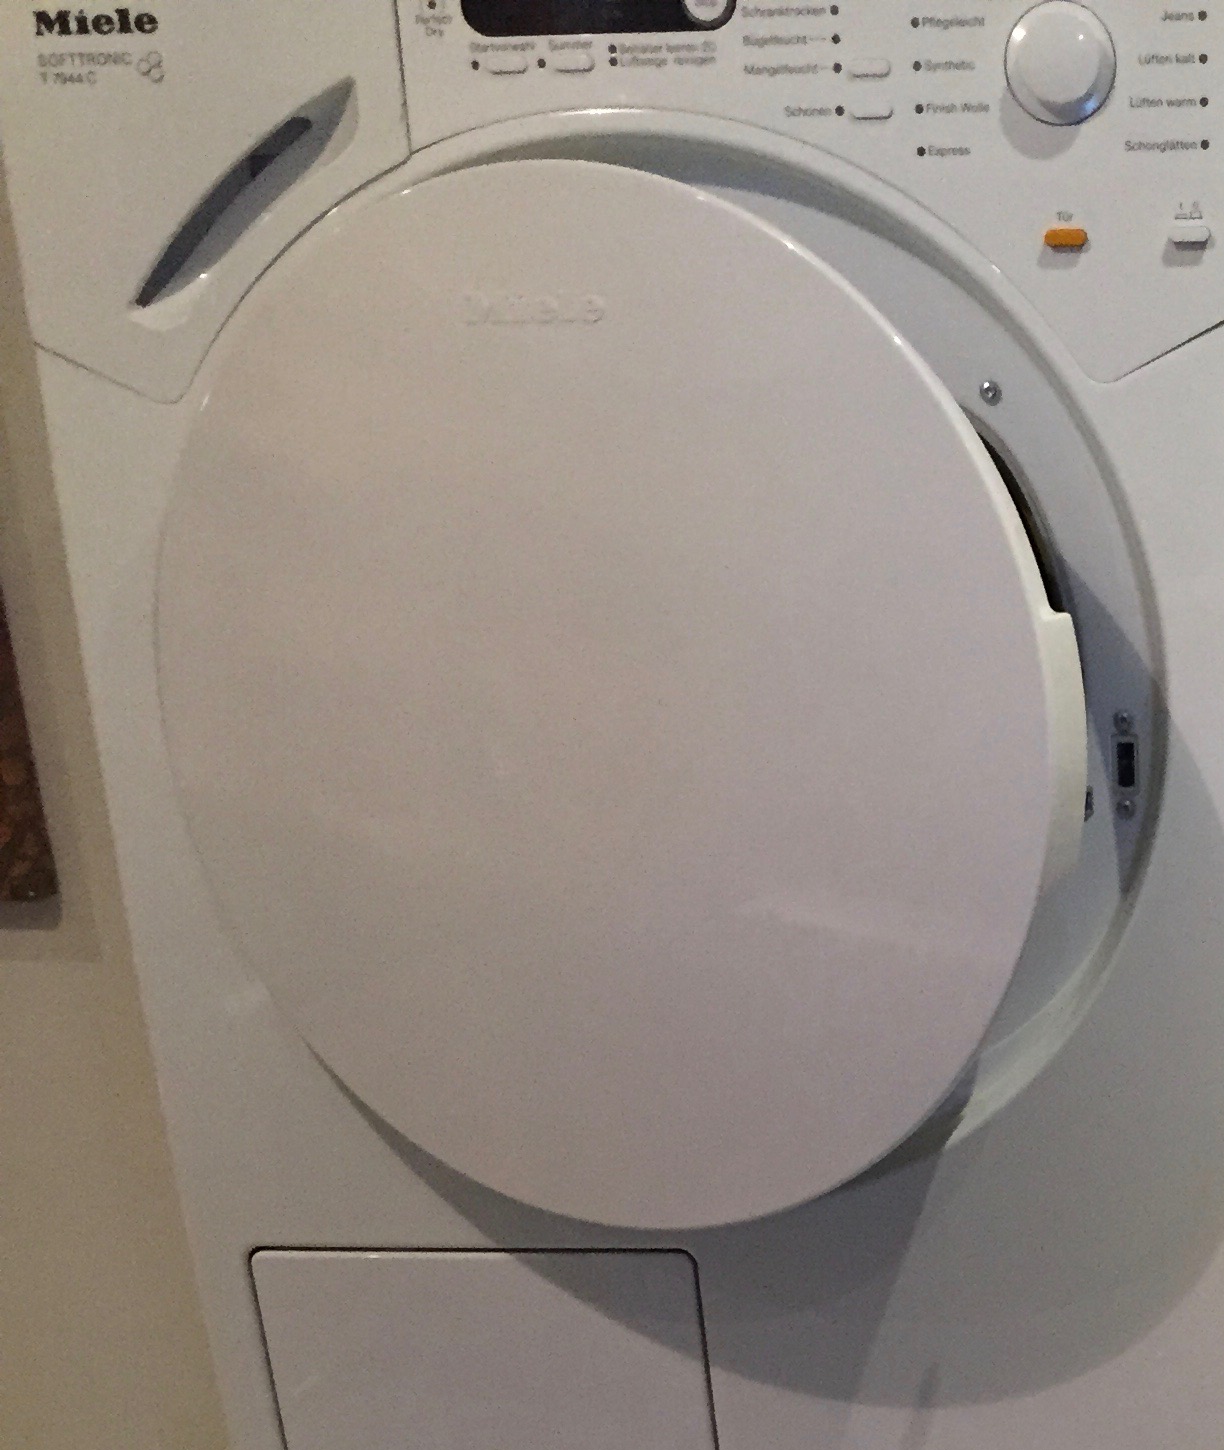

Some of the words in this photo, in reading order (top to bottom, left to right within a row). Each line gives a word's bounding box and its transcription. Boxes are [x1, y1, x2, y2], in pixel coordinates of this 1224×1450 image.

[33, 8, 159, 35] Miele
[1161, 10, 1195, 21] Jeans
[37, 52, 133, 67] SOFTTRONIC
[1175, 52, 1195, 64] kalt
[1166, 97, 1197, 108] warm
[1124, 139, 1199, 153] Schonglätten
